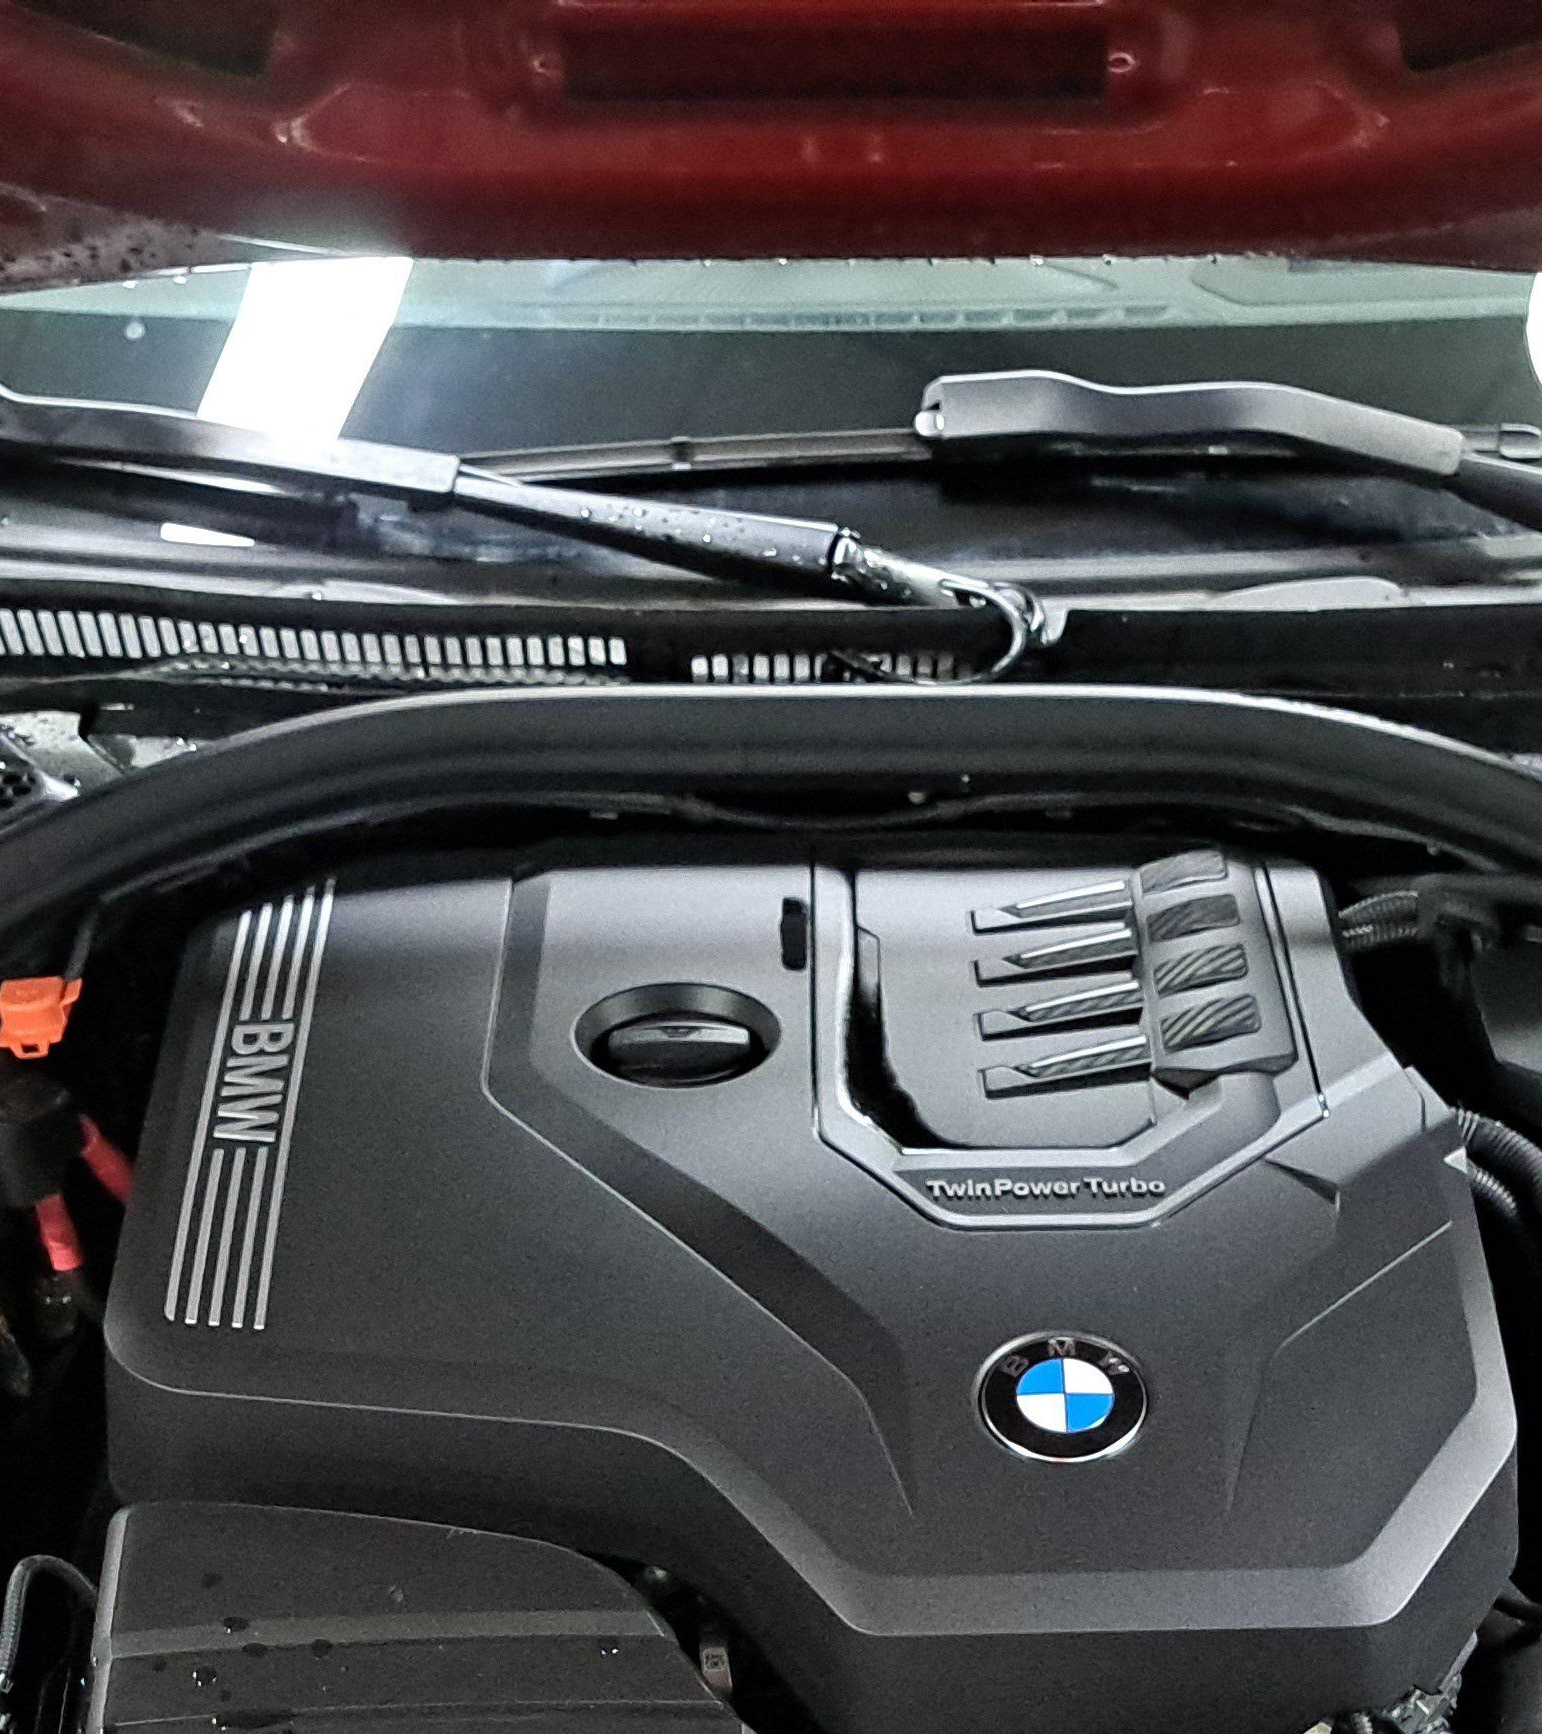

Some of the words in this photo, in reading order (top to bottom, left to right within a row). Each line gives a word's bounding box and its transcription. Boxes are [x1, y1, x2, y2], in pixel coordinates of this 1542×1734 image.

[213, 1022, 295, 1142] BMW
[925, 1178, 1081, 1199] TwinPower
[1083, 1177, 1166, 1197] Turbo
[1000, 1338, 1130, 1378] BMW
